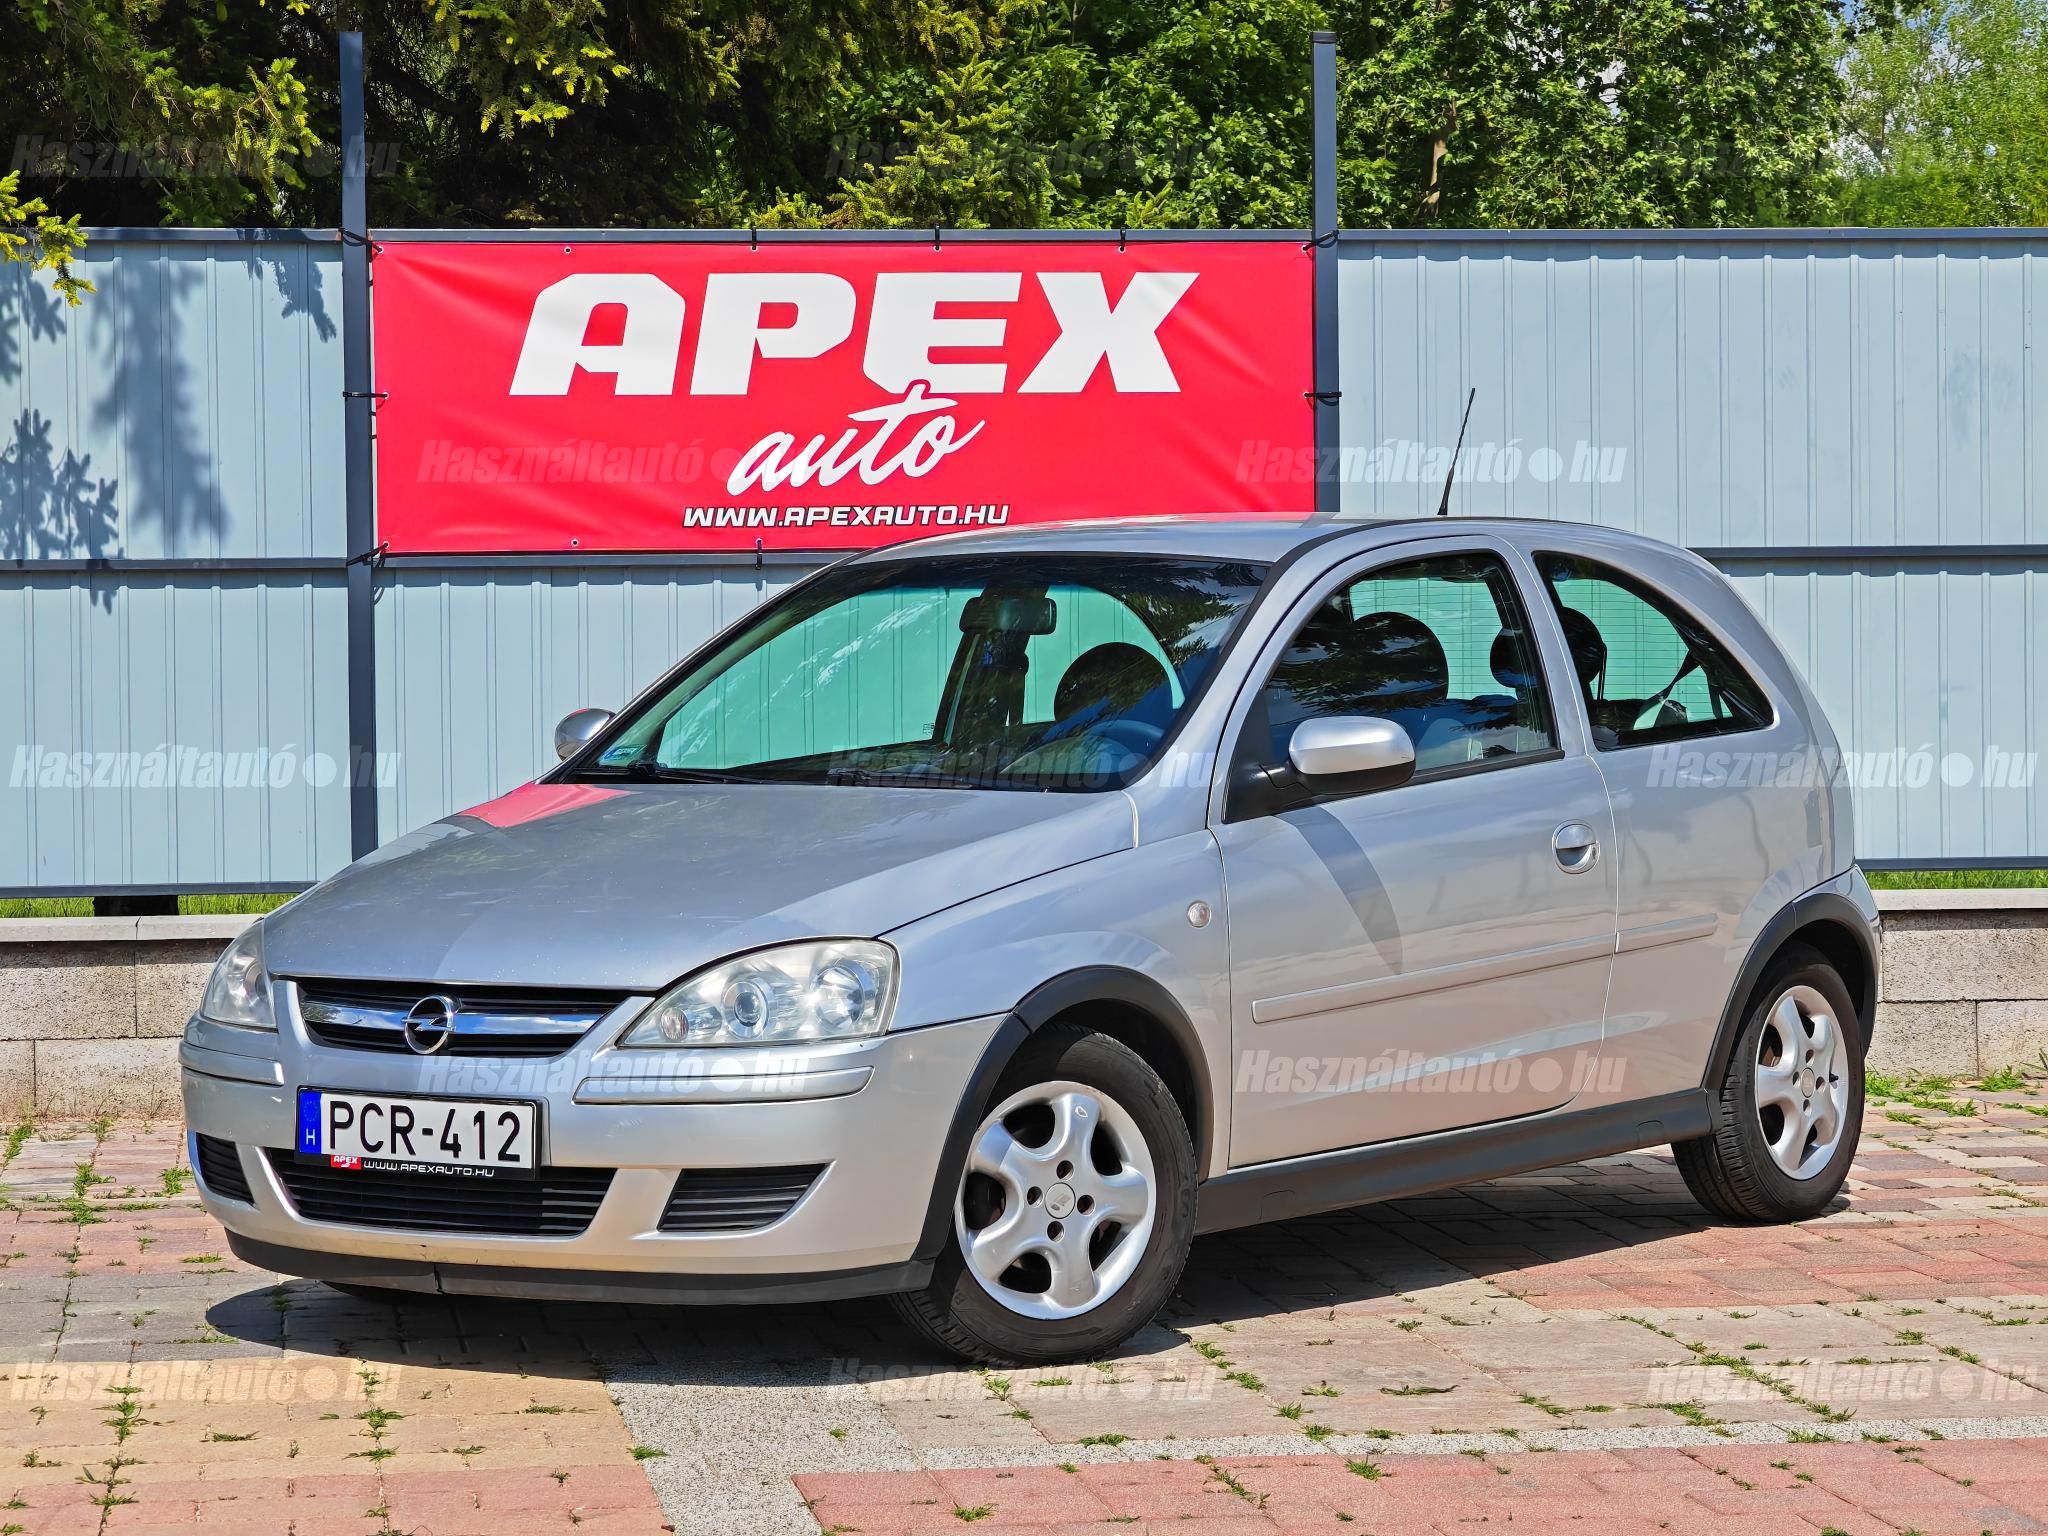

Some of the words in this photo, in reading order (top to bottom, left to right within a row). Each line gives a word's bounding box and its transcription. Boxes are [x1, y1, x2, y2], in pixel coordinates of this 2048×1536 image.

[509, 272, 1200, 395] APEX
[726, 383, 985, 496] auto
[682, 504, 1010, 528] WWW.APEXAUTO.HU
[305, 1128, 316, 1146] H
[329, 1100, 521, 1163] PCR-412
[333, 1155, 358, 1165] APEX
[363, 1160, 495, 1177] WWW.APEXAUTO.HU
